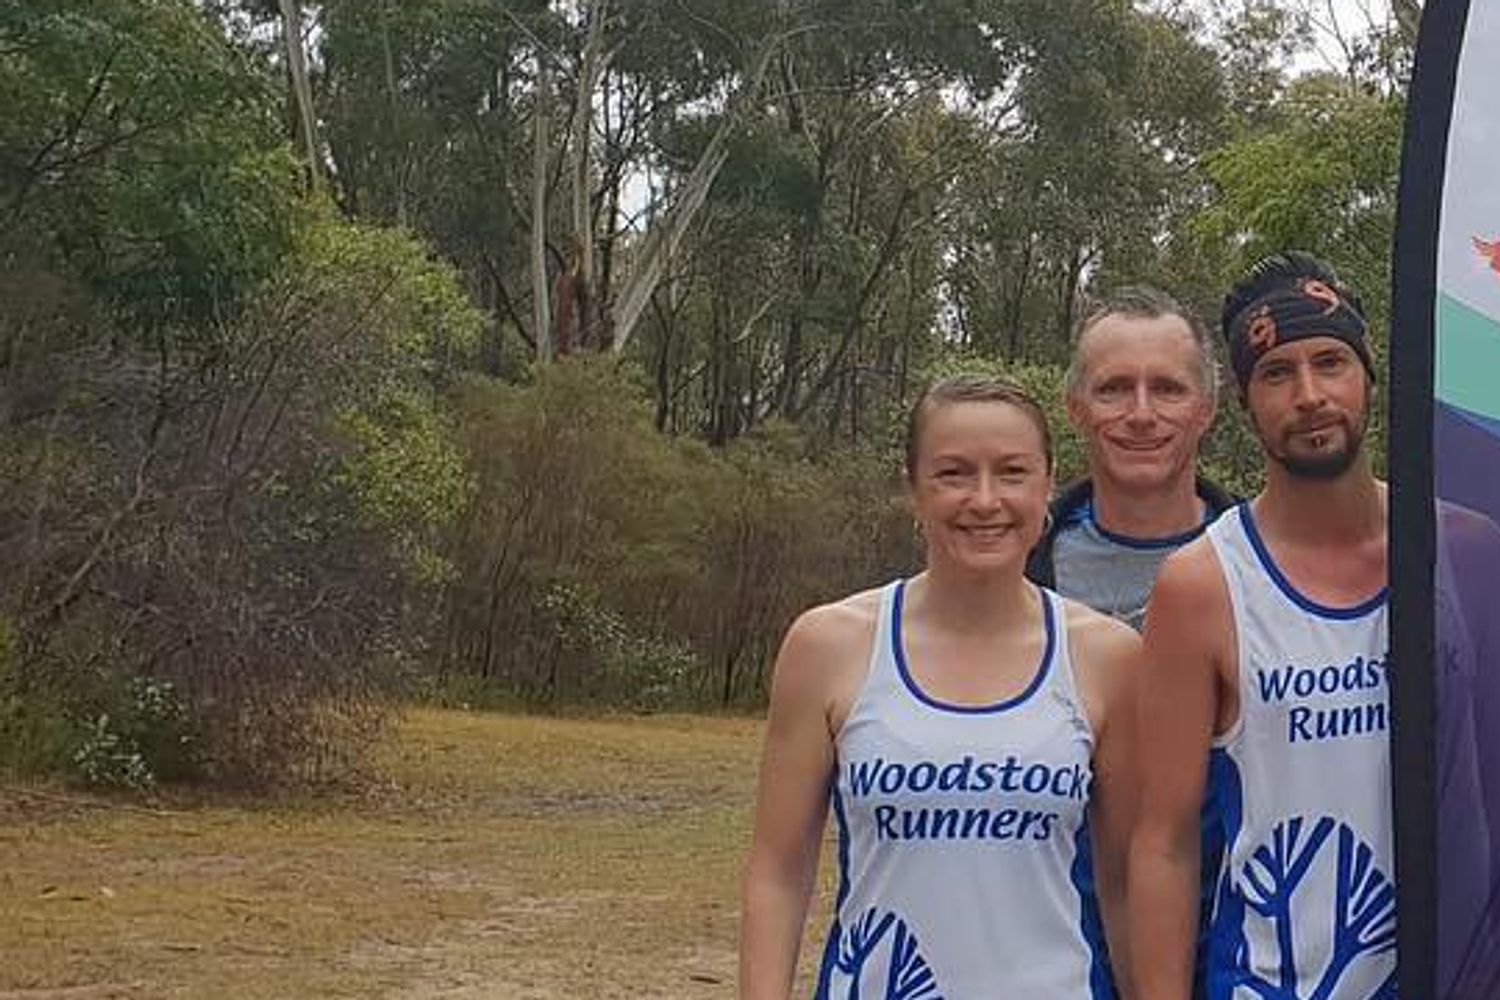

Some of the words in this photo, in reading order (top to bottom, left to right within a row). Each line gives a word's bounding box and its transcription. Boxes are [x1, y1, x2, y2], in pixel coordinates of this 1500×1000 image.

[1257, 655, 1391, 702] Woodst
[1288, 702, 1385, 743] Runn
[848, 755, 1084, 800] Woodstock
[874, 804, 1060, 843] Runners
